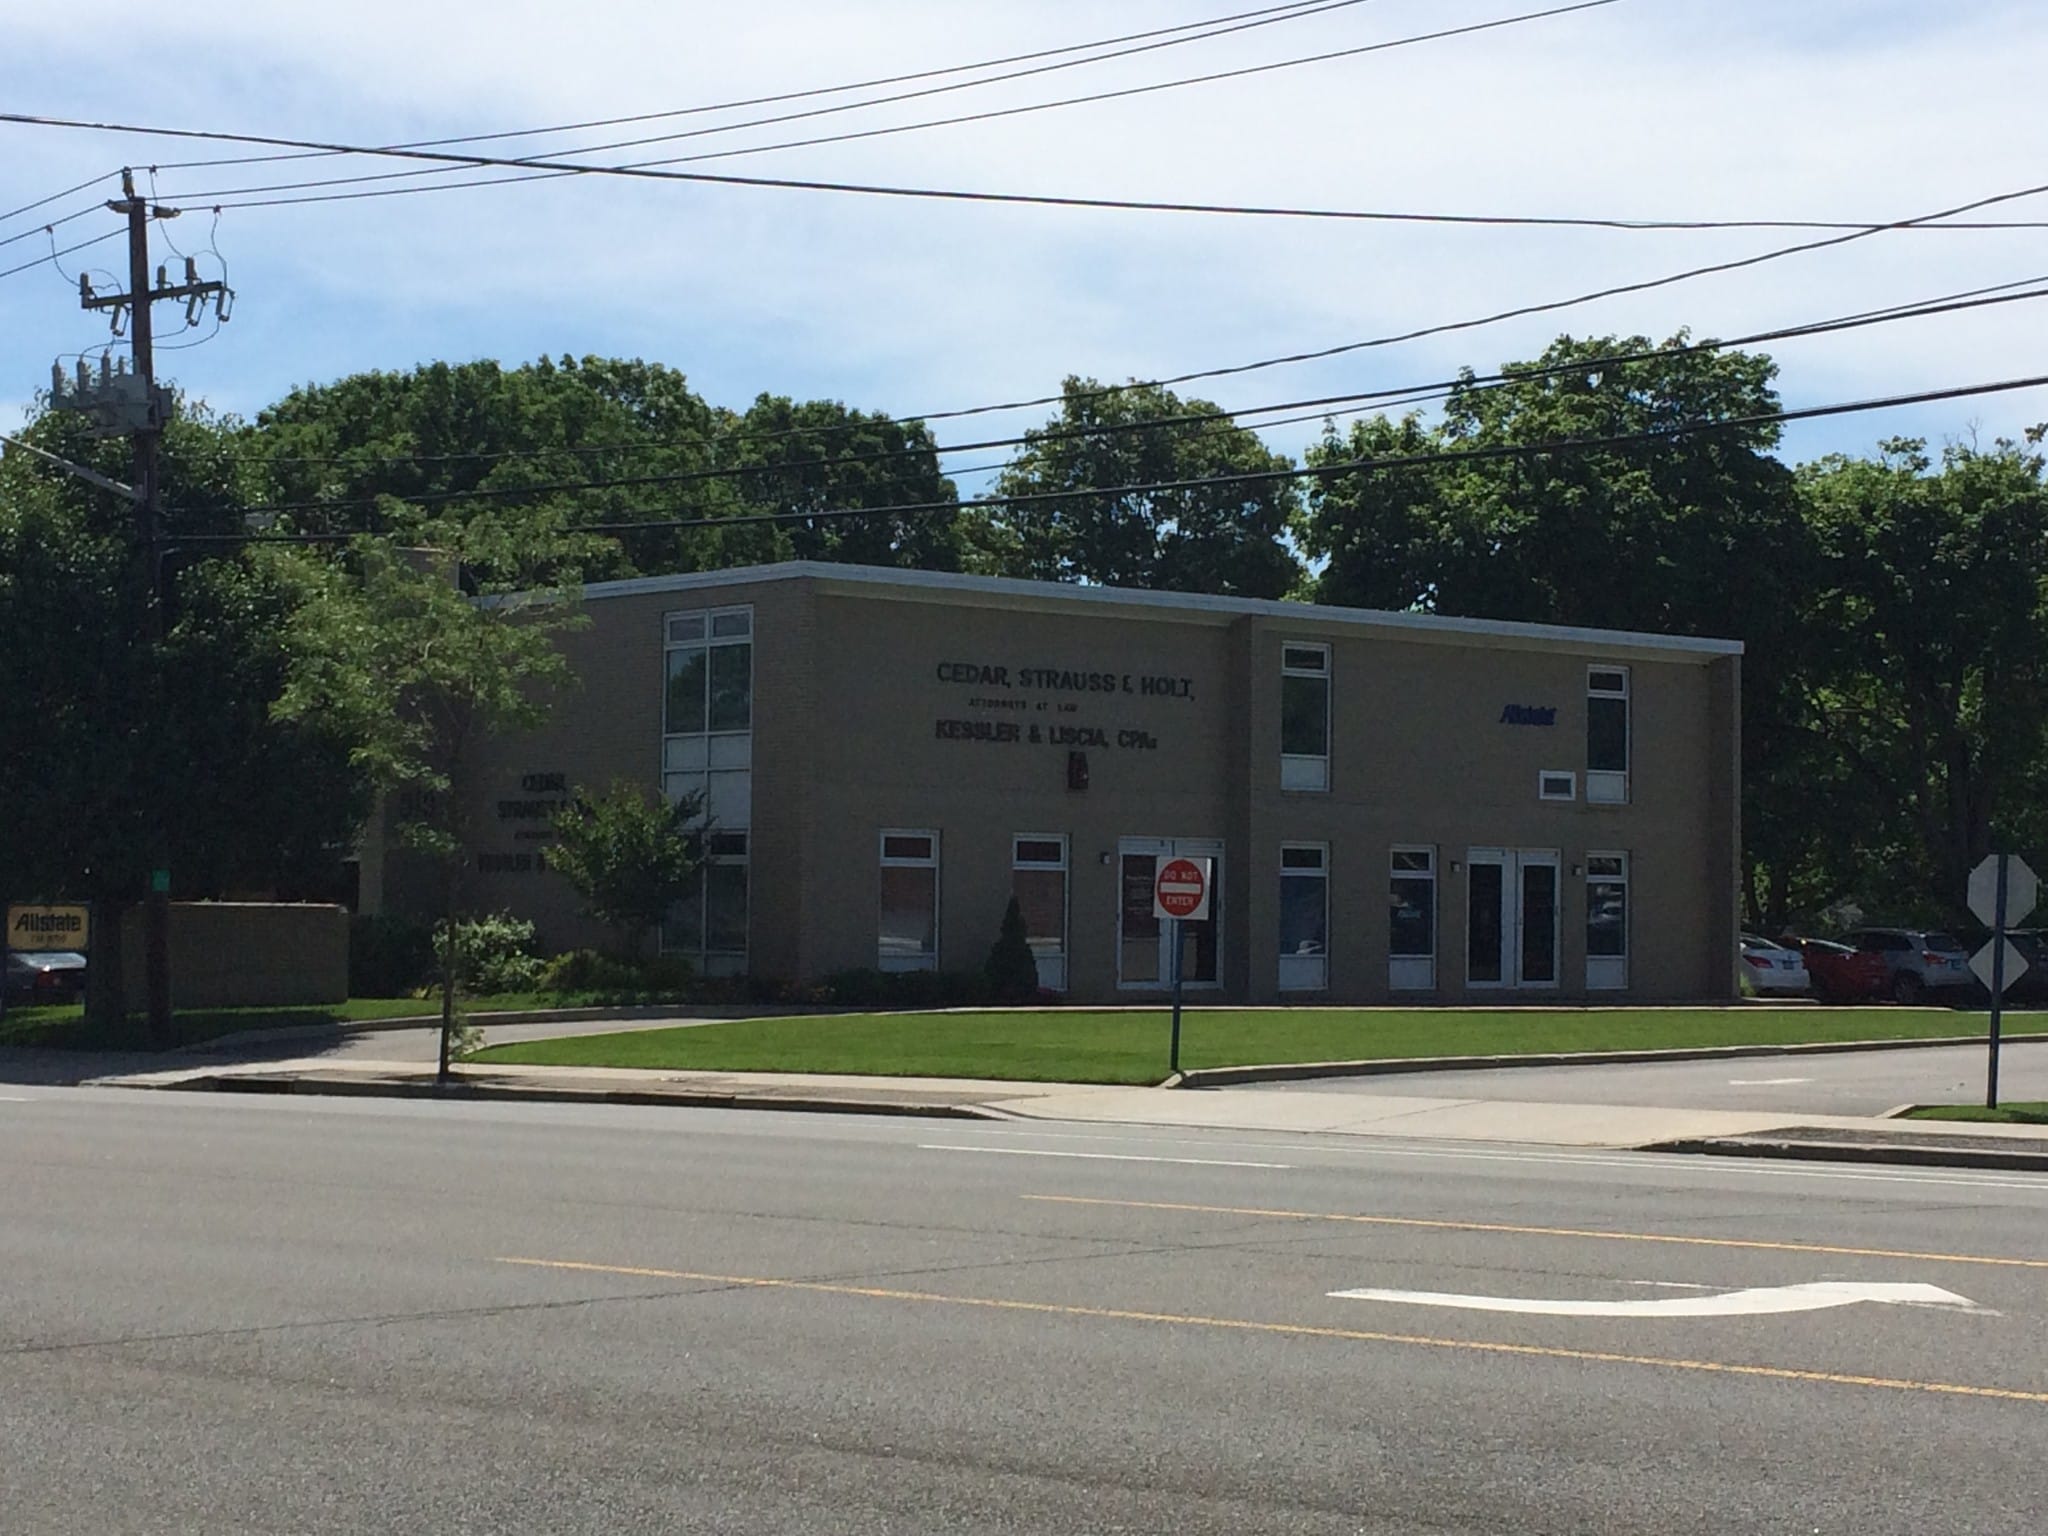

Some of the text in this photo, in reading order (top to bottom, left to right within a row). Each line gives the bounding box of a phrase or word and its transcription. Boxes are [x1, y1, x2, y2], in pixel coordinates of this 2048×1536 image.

[937, 662, 1011, 689] CEDAR,
[1017, 668, 1117, 692] STRAUSS
[1140, 674, 1196, 701] HOLT,
[935, 719, 1020, 743] KESSLER
[1028, 724, 1043, 744] &
[1164, 869, 1177, 880] DO
[1181, 871, 1199, 881] NOT
[1166, 895, 1194, 906] ENTER
[14, 912, 81, 932] Allstate
